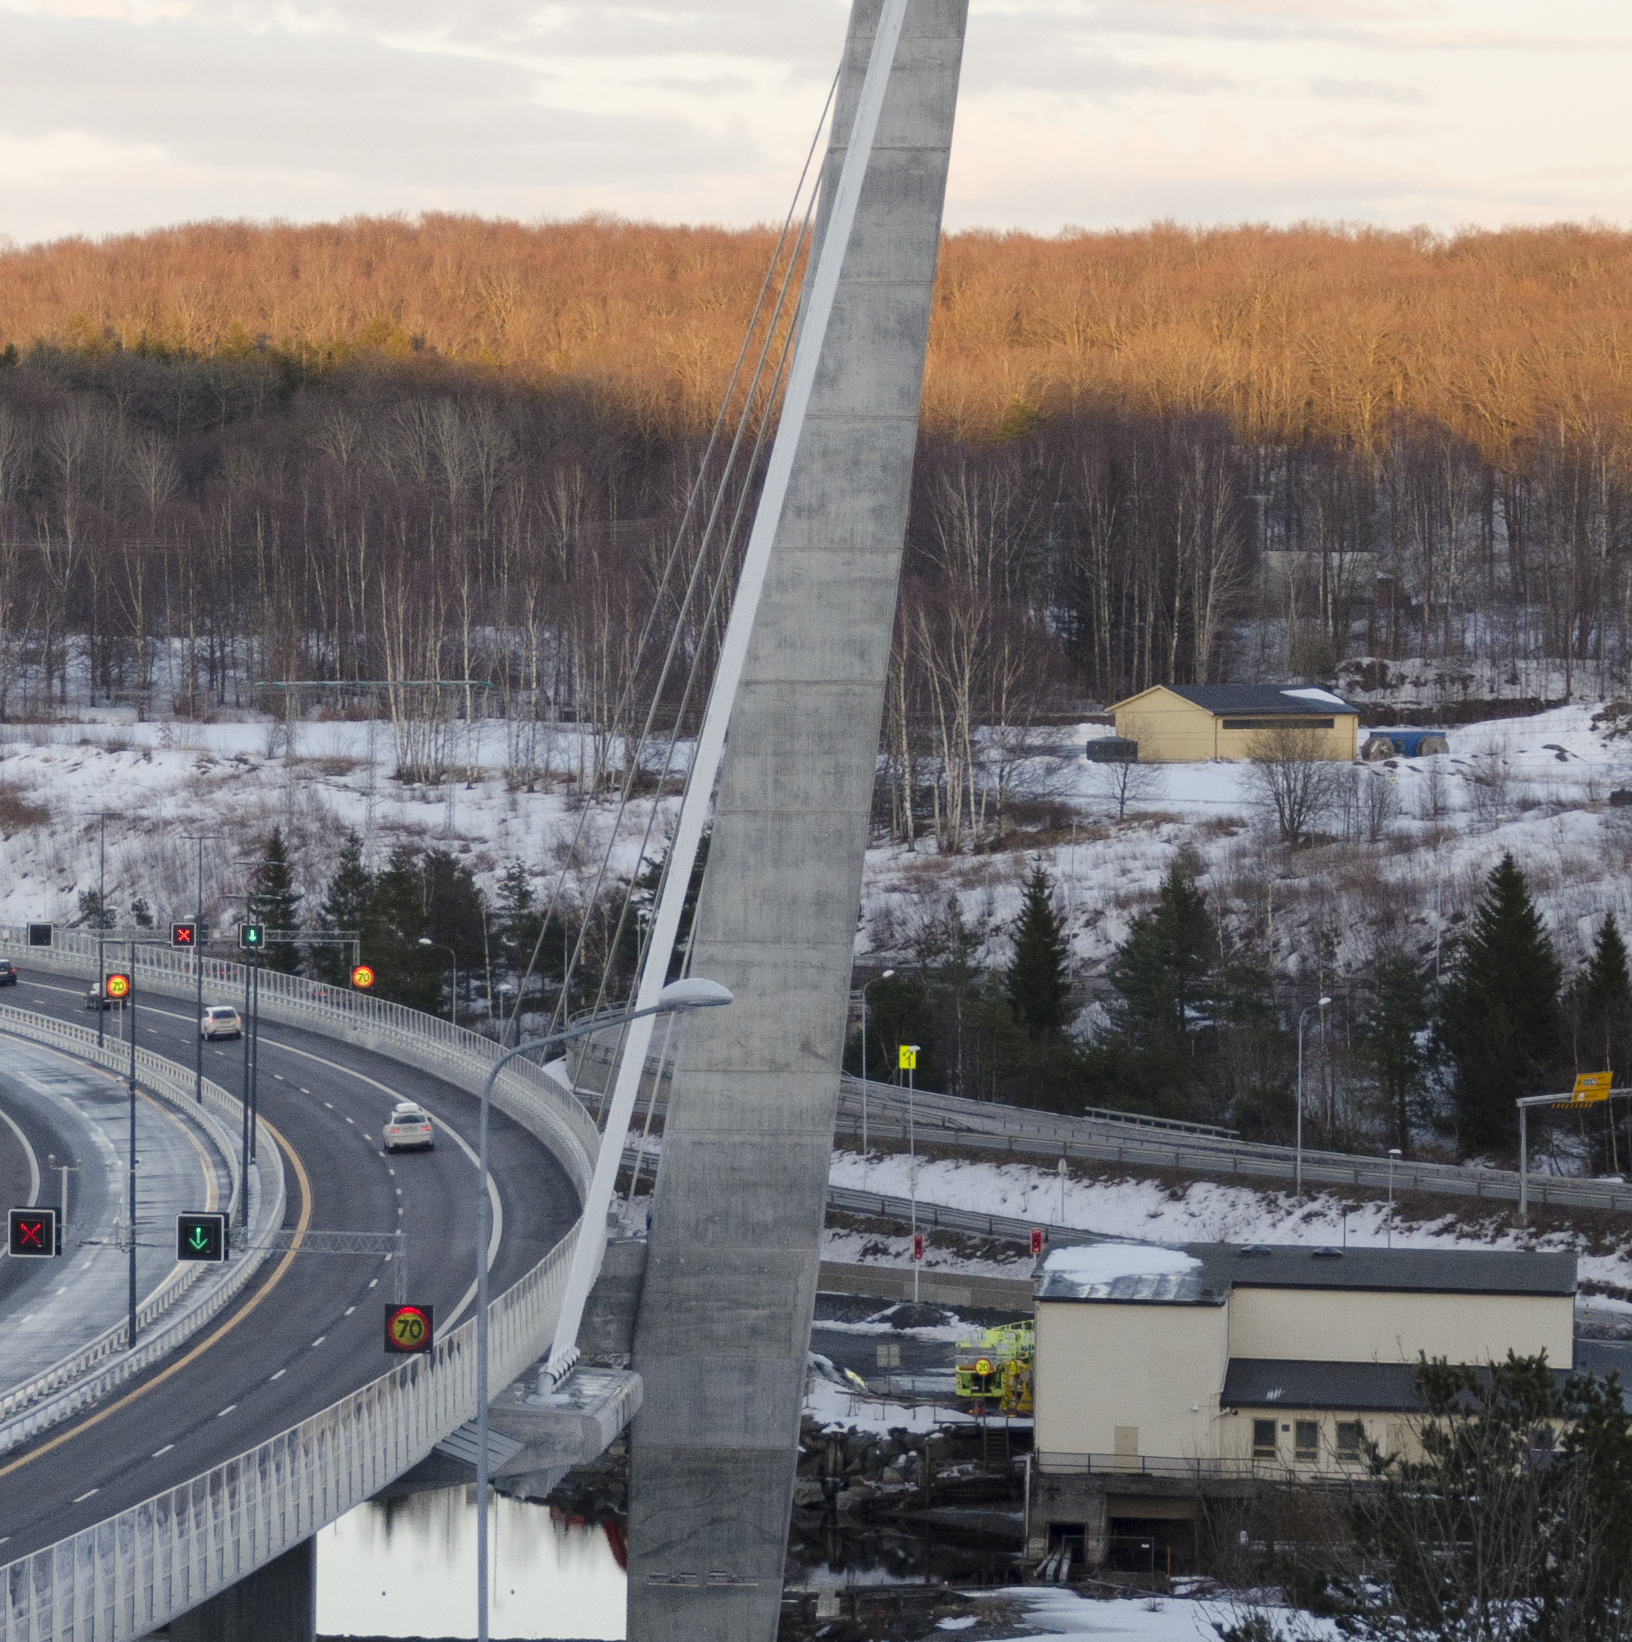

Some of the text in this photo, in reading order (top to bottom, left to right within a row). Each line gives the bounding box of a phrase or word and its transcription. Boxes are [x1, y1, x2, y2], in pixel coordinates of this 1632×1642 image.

[358, 972, 370, 982] 70
[112, 982, 124, 992] 70
[398, 1319, 422, 1340] 70
